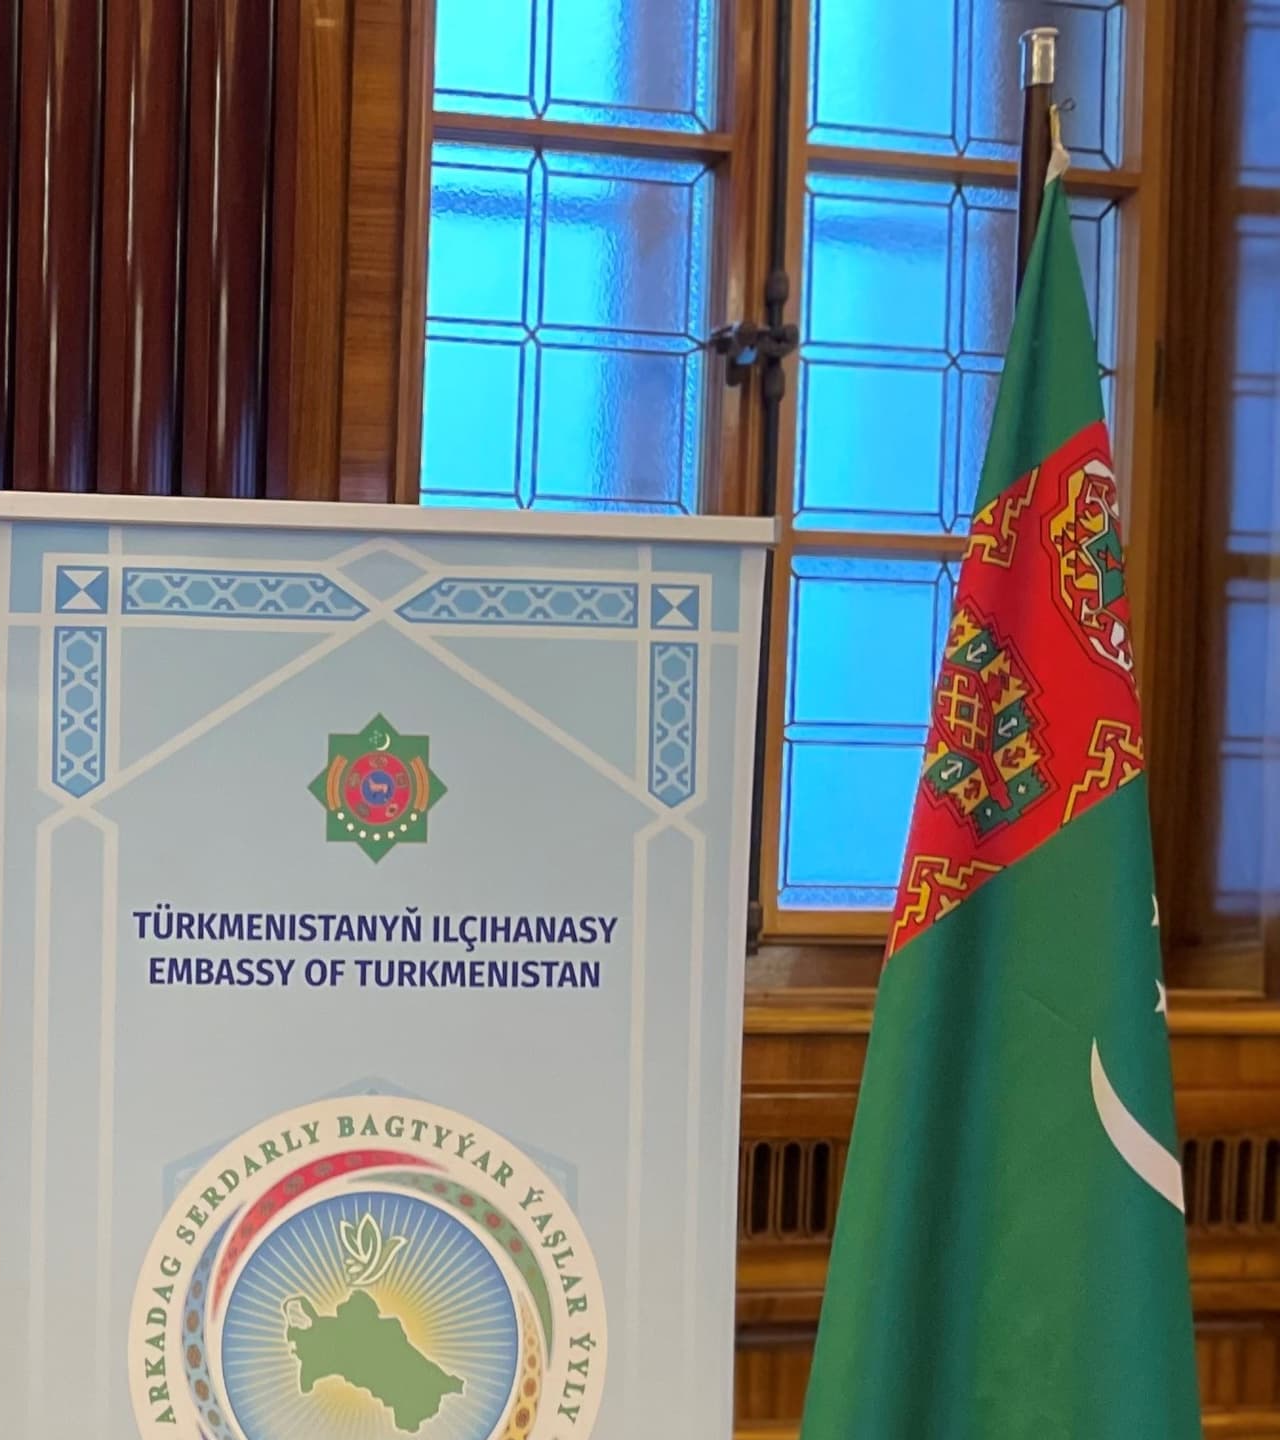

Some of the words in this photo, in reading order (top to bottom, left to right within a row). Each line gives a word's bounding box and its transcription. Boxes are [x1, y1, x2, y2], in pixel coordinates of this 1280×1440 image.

[133, 904, 421, 941] TÜRKMENISTANYŇ
[433, 916, 618, 952] ILÇIHANASY
[150, 958, 295, 986] EMBASSY
[305, 959, 345, 986] OF
[354, 960, 599, 987] TURKMENISTAN
[145, 1255, 181, 1424] ARKADAG
[176, 1120, 320, 1245] SERDARLY
